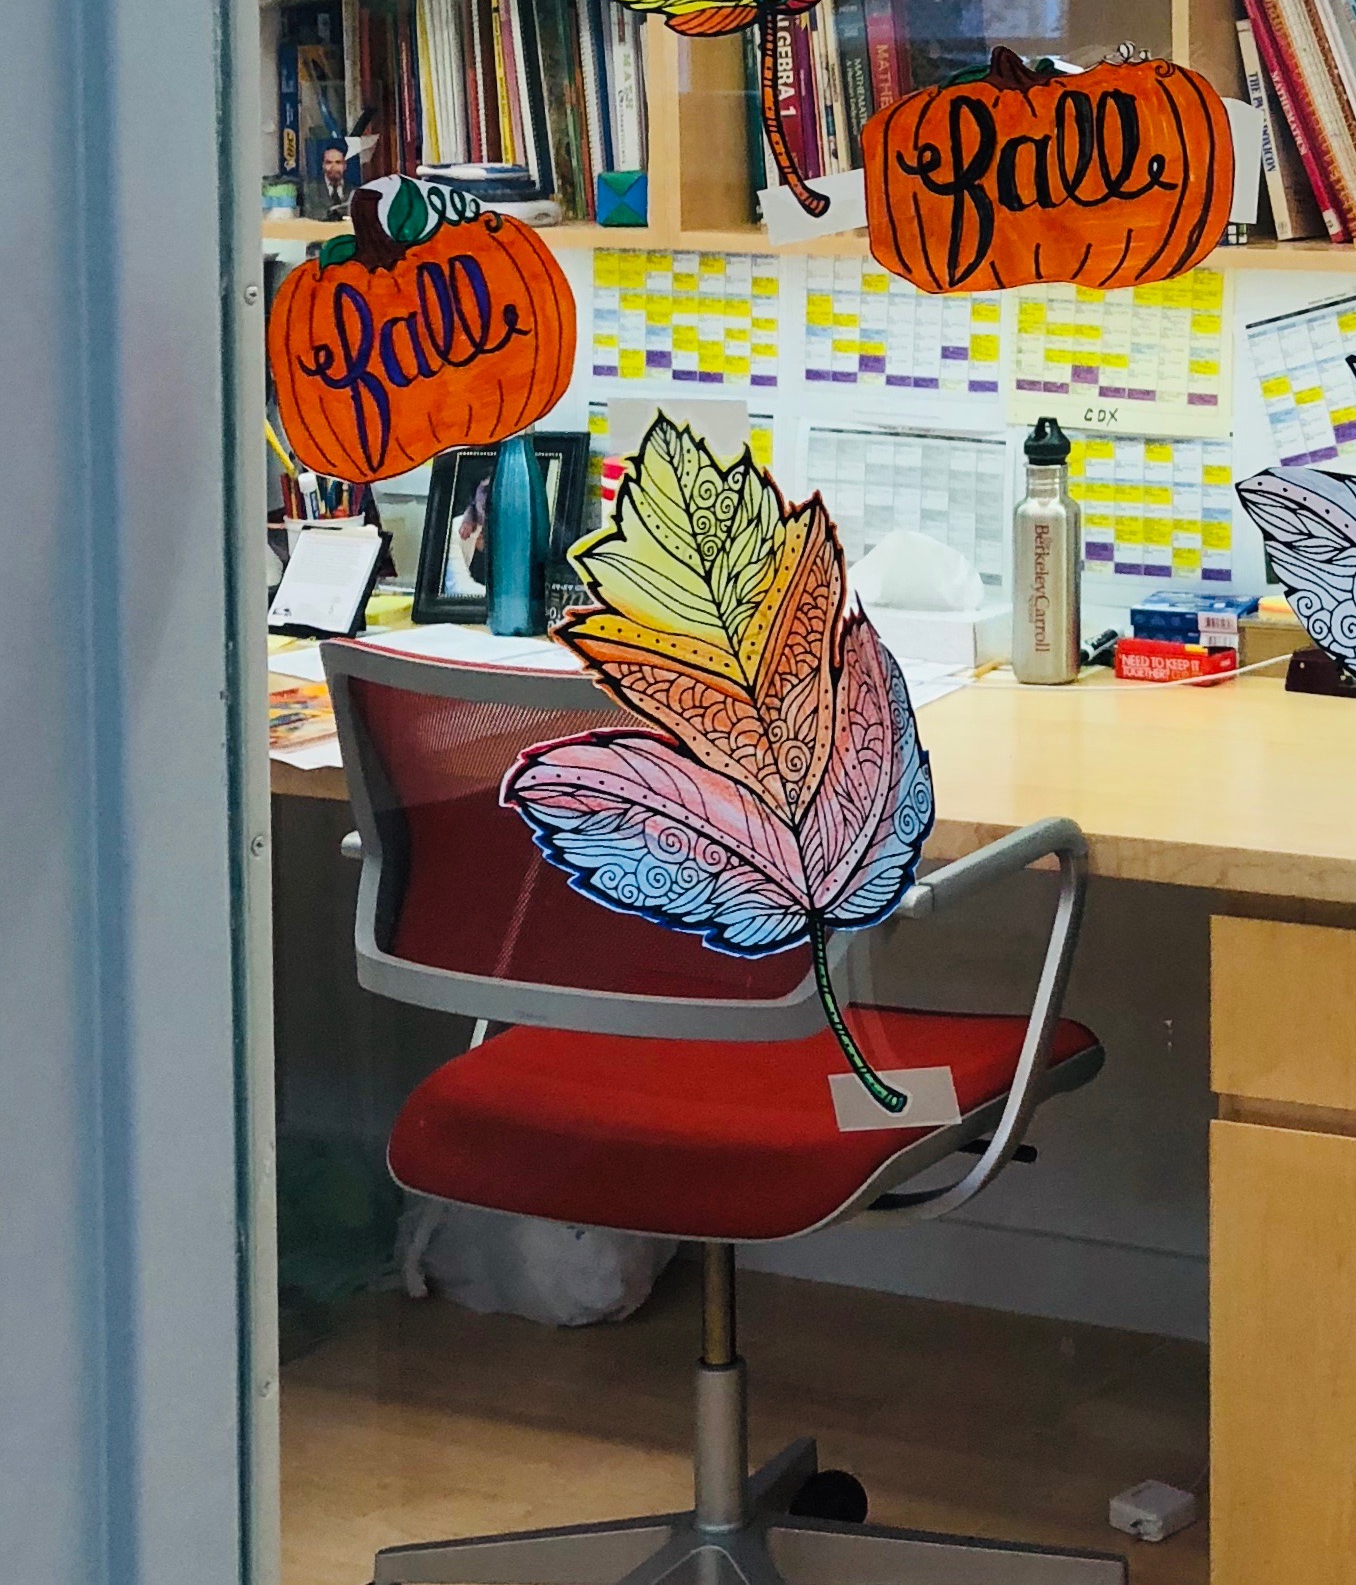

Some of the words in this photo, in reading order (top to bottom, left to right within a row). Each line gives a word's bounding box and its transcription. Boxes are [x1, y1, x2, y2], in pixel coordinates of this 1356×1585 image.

[780, 108, 797, 117] 1
[1248, 71, 1260, 96] THE
[1270, 70, 1308, 155] MATHEMATICS
[1252, 97, 1277, 173] PADOXICON
[896, 90, 1177, 288] fall
[297, 255, 531, 473] fall
[1150, 656, 1164, 667] TO
[1165, 657, 1189, 669] KEEP
[1190, 659, 1200, 671] IT
